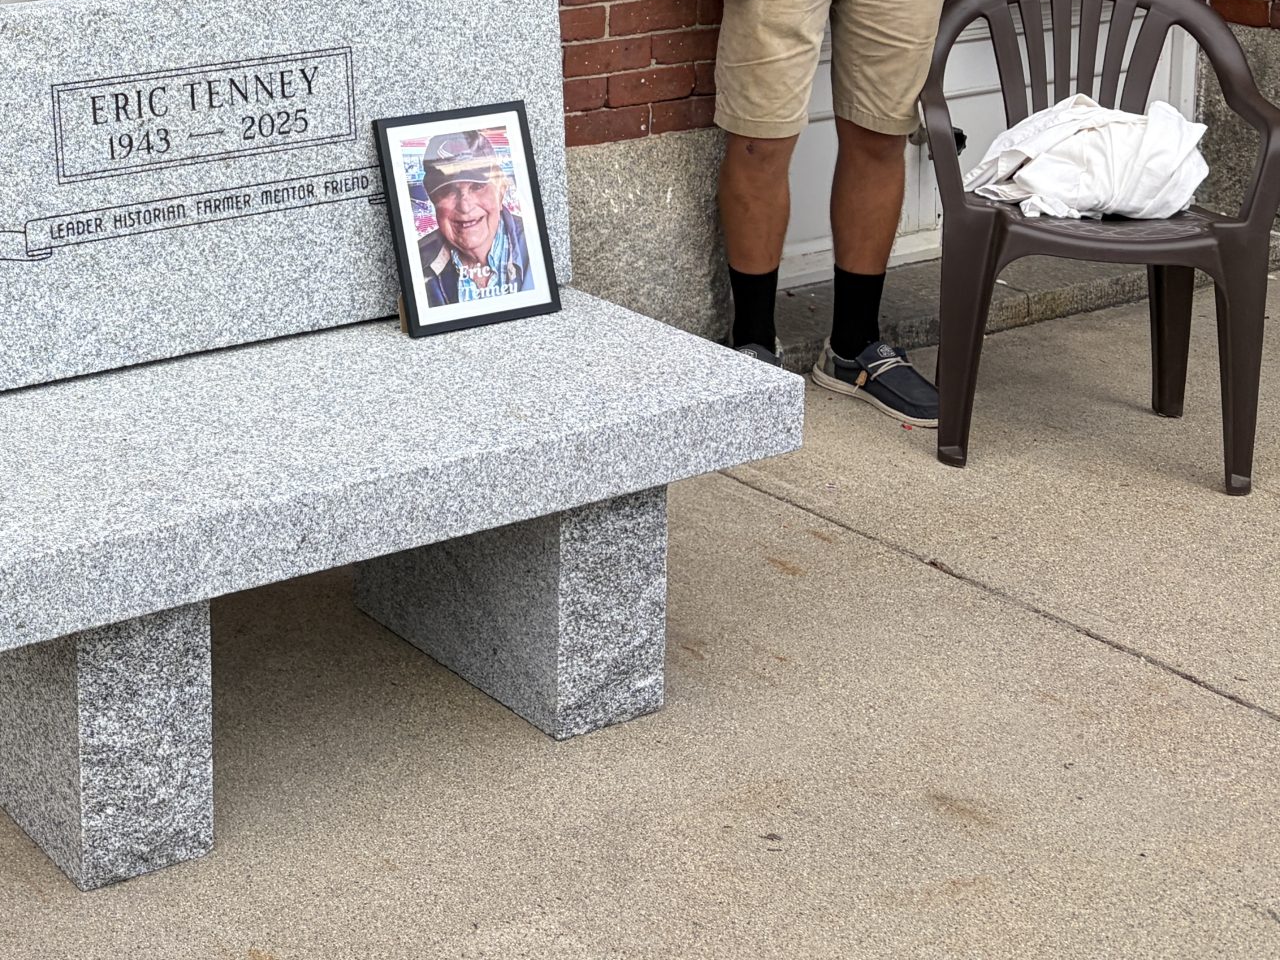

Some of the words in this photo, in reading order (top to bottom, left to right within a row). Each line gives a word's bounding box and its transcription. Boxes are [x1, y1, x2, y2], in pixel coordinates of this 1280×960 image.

[91, 86, 169, 126] ERIC
[183, 66, 319, 111] TENNEY
[109, 128, 171, 160] 1943
[242, 109, 309, 140] 2025
[50, 218, 103, 240] LEADER
[113, 203, 187, 230] HISTORIAN
[196, 194, 252, 216] FARMER
[261, 183, 315, 205] MENTOR
[324, 175, 370, 196] FRIEND
[459, 262, 491, 280] Eric
[463, 282, 518, 302] Tenney
